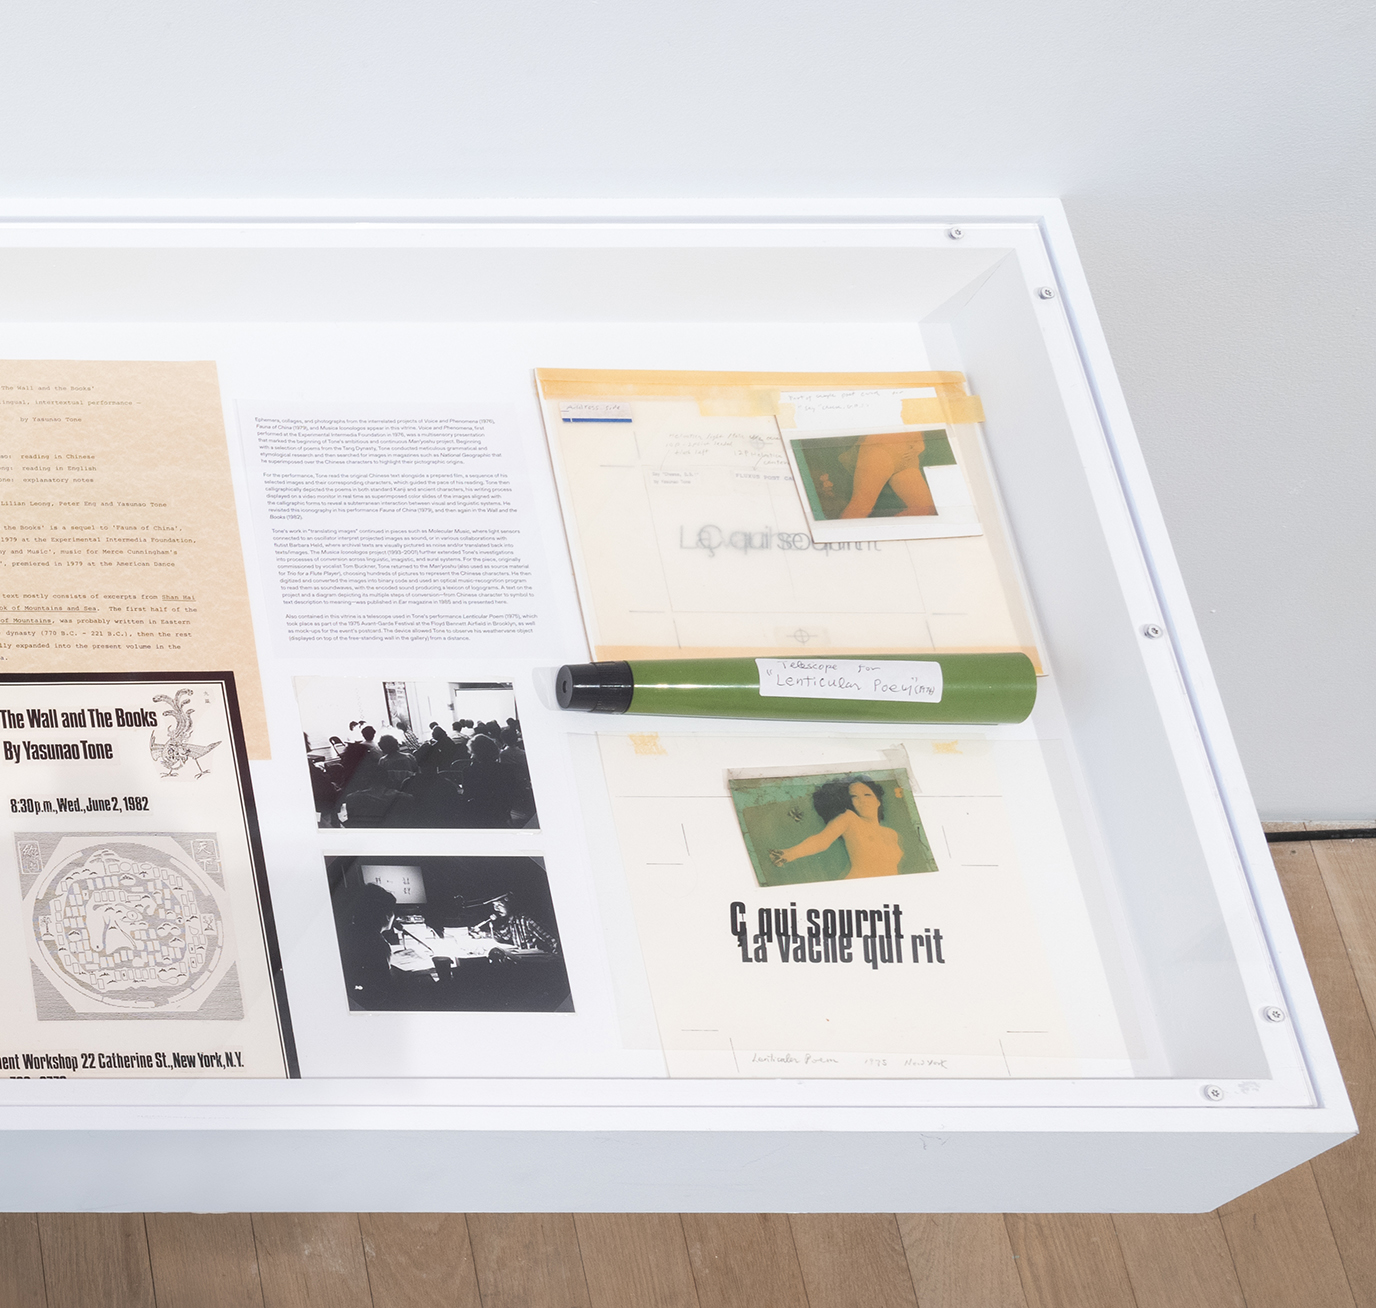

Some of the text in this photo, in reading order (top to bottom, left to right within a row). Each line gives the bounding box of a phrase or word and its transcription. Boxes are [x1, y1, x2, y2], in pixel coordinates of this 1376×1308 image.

[0, 707, 158, 729] The Wall and The Books
[3, 740, 113, 764] By Yasunao Tone
[123, 796, 149, 811] 1982
[758, 902, 798, 942] qui
[806, 904, 904, 939] sourrit
[741, 928, 945, 969] La vache qui rit
[22, 1053, 78, 1072] Workshop
[80, 1053, 96, 1069] 22
[98, 1053, 153, 1069] Catherine
[172, 1052, 196, 1069] New
[226, 1052, 244, 1068] N.Y.
